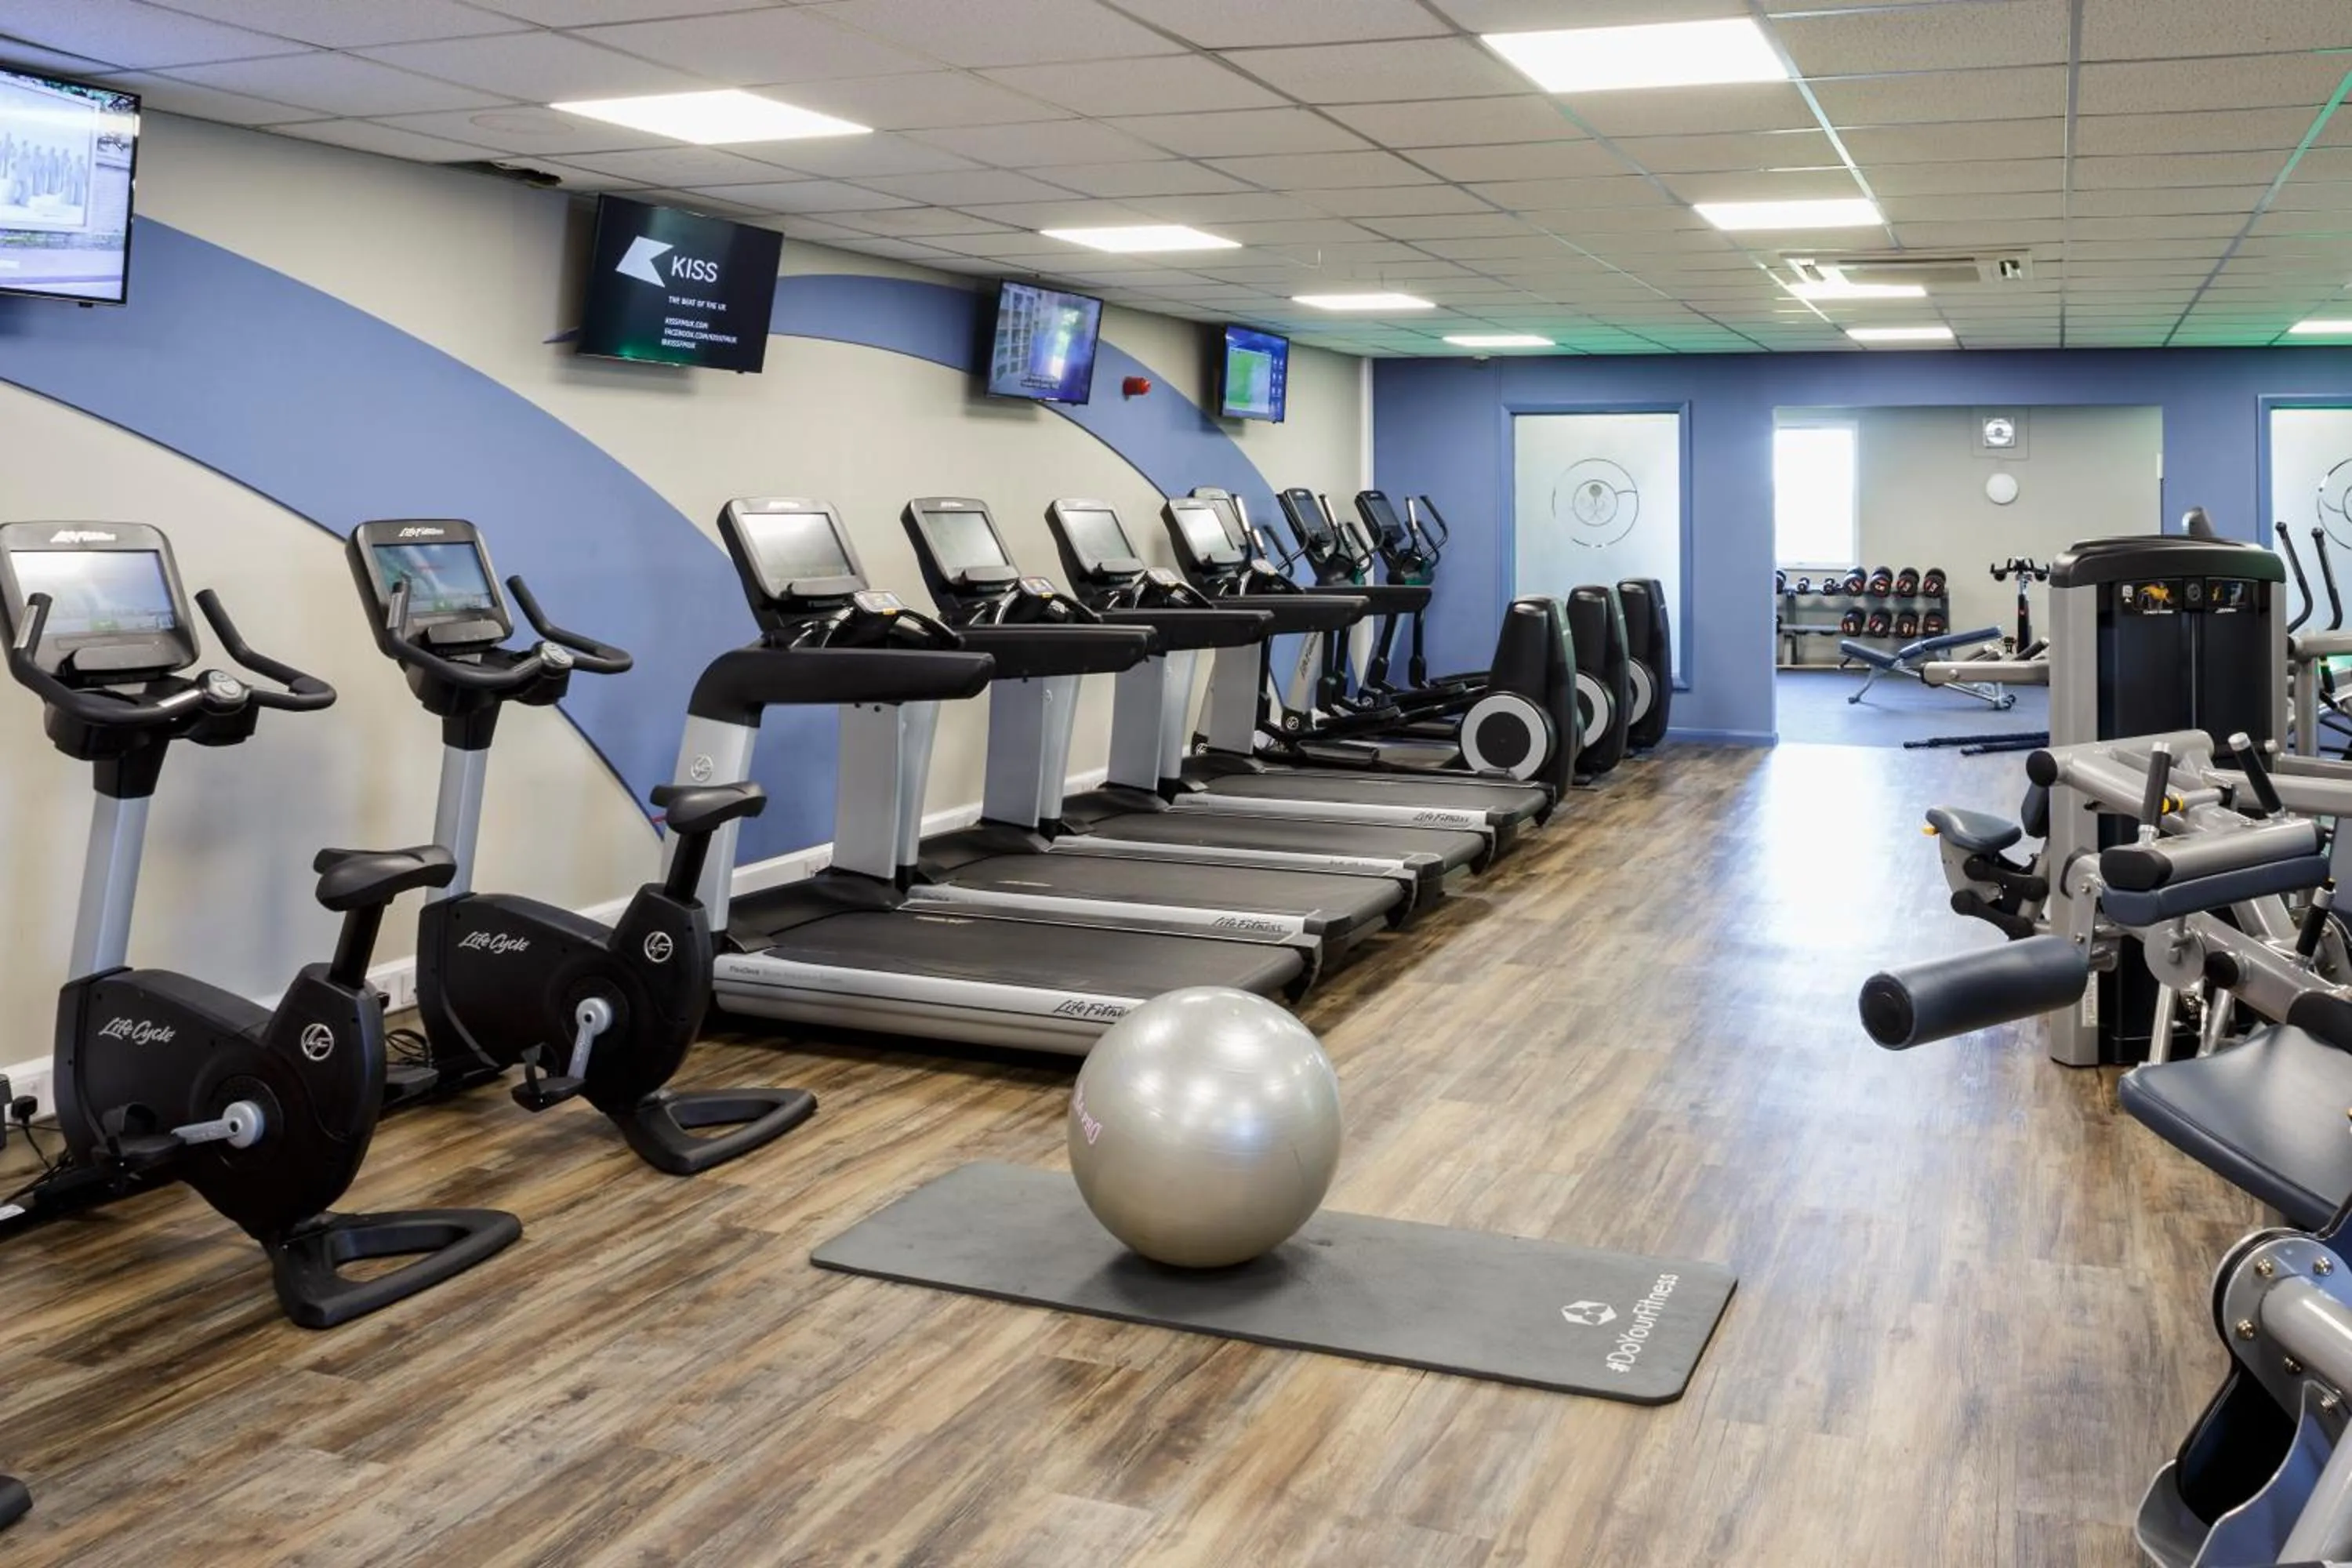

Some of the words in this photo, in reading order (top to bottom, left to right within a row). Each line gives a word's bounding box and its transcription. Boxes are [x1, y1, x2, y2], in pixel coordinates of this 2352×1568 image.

[671, 256, 718, 283] KISS
[458, 931, 491, 950] Life
[489, 933, 531, 954] Cycle
[1053, 1000, 1086, 1016] Life
[98, 1018, 133, 1040] Life
[132, 1020, 176, 1045] Cycle
